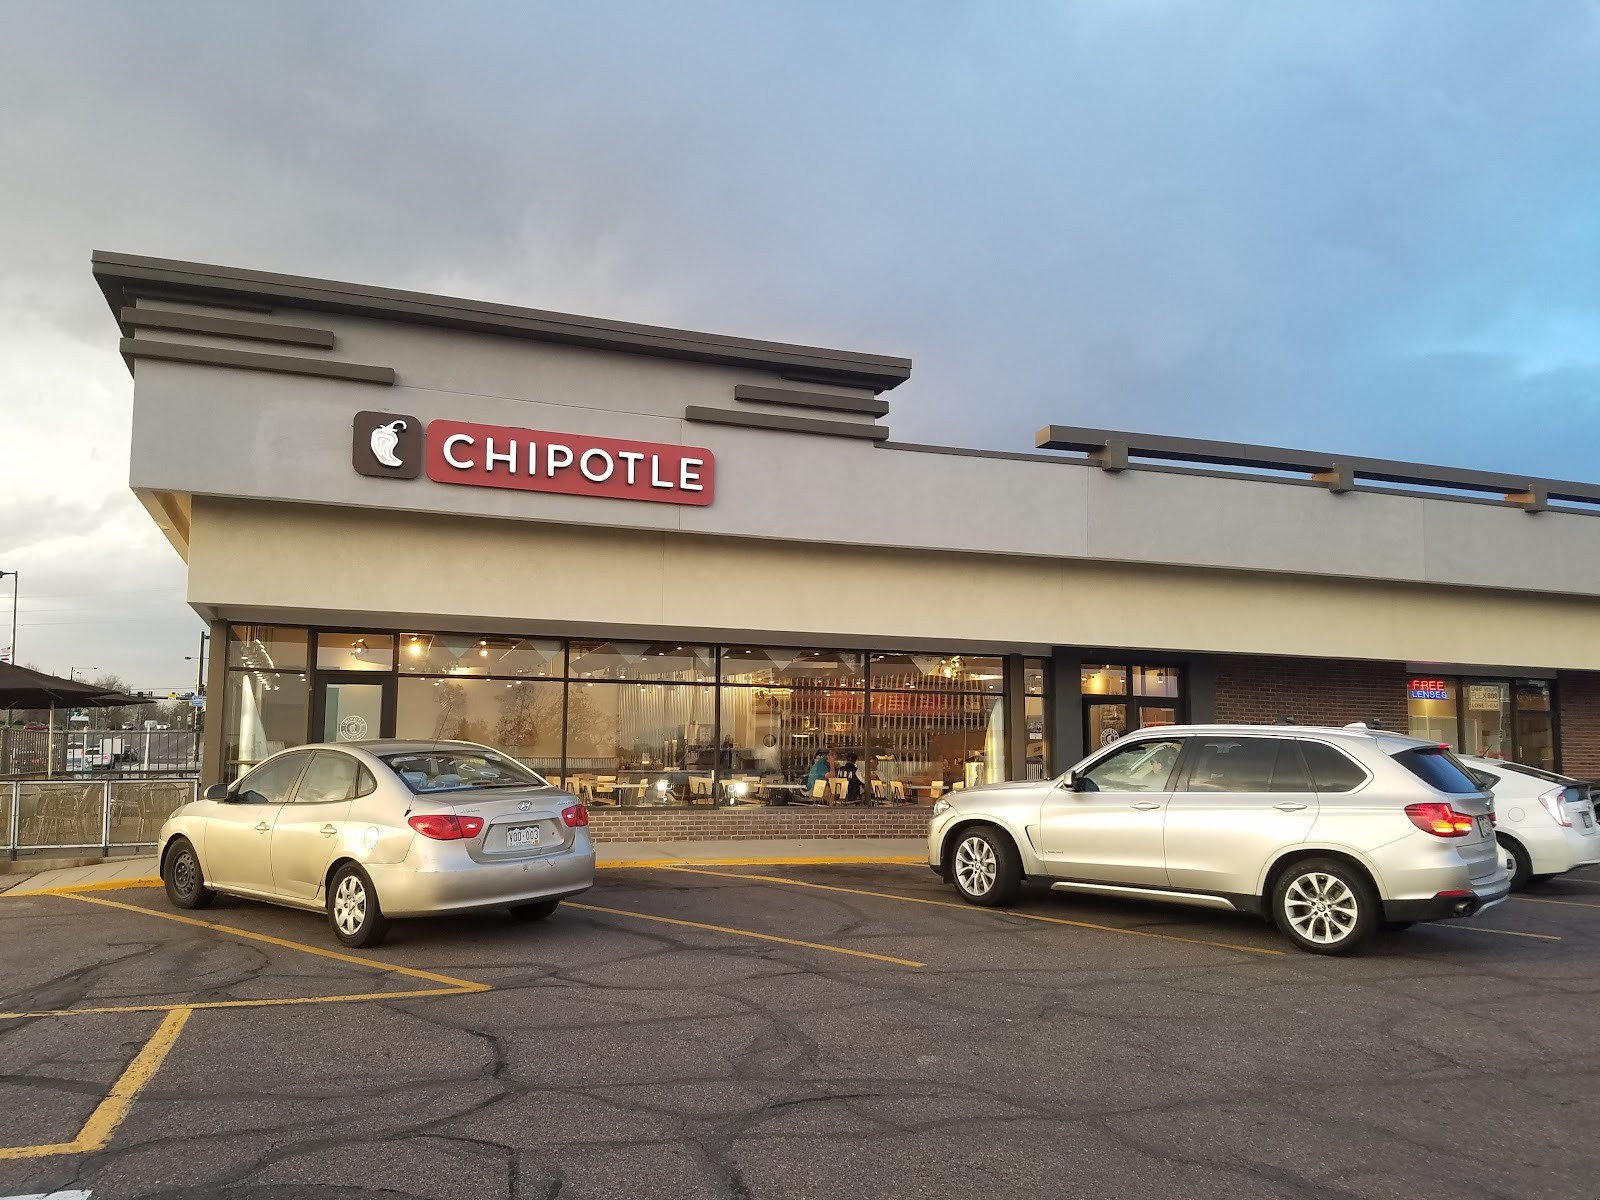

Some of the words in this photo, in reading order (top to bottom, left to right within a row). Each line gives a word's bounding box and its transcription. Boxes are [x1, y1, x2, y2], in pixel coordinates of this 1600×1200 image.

[443, 434, 704, 491] CHIPOTLE
[1413, 680, 1444, 691] FREE
[1411, 690, 1448, 699] LENSES
